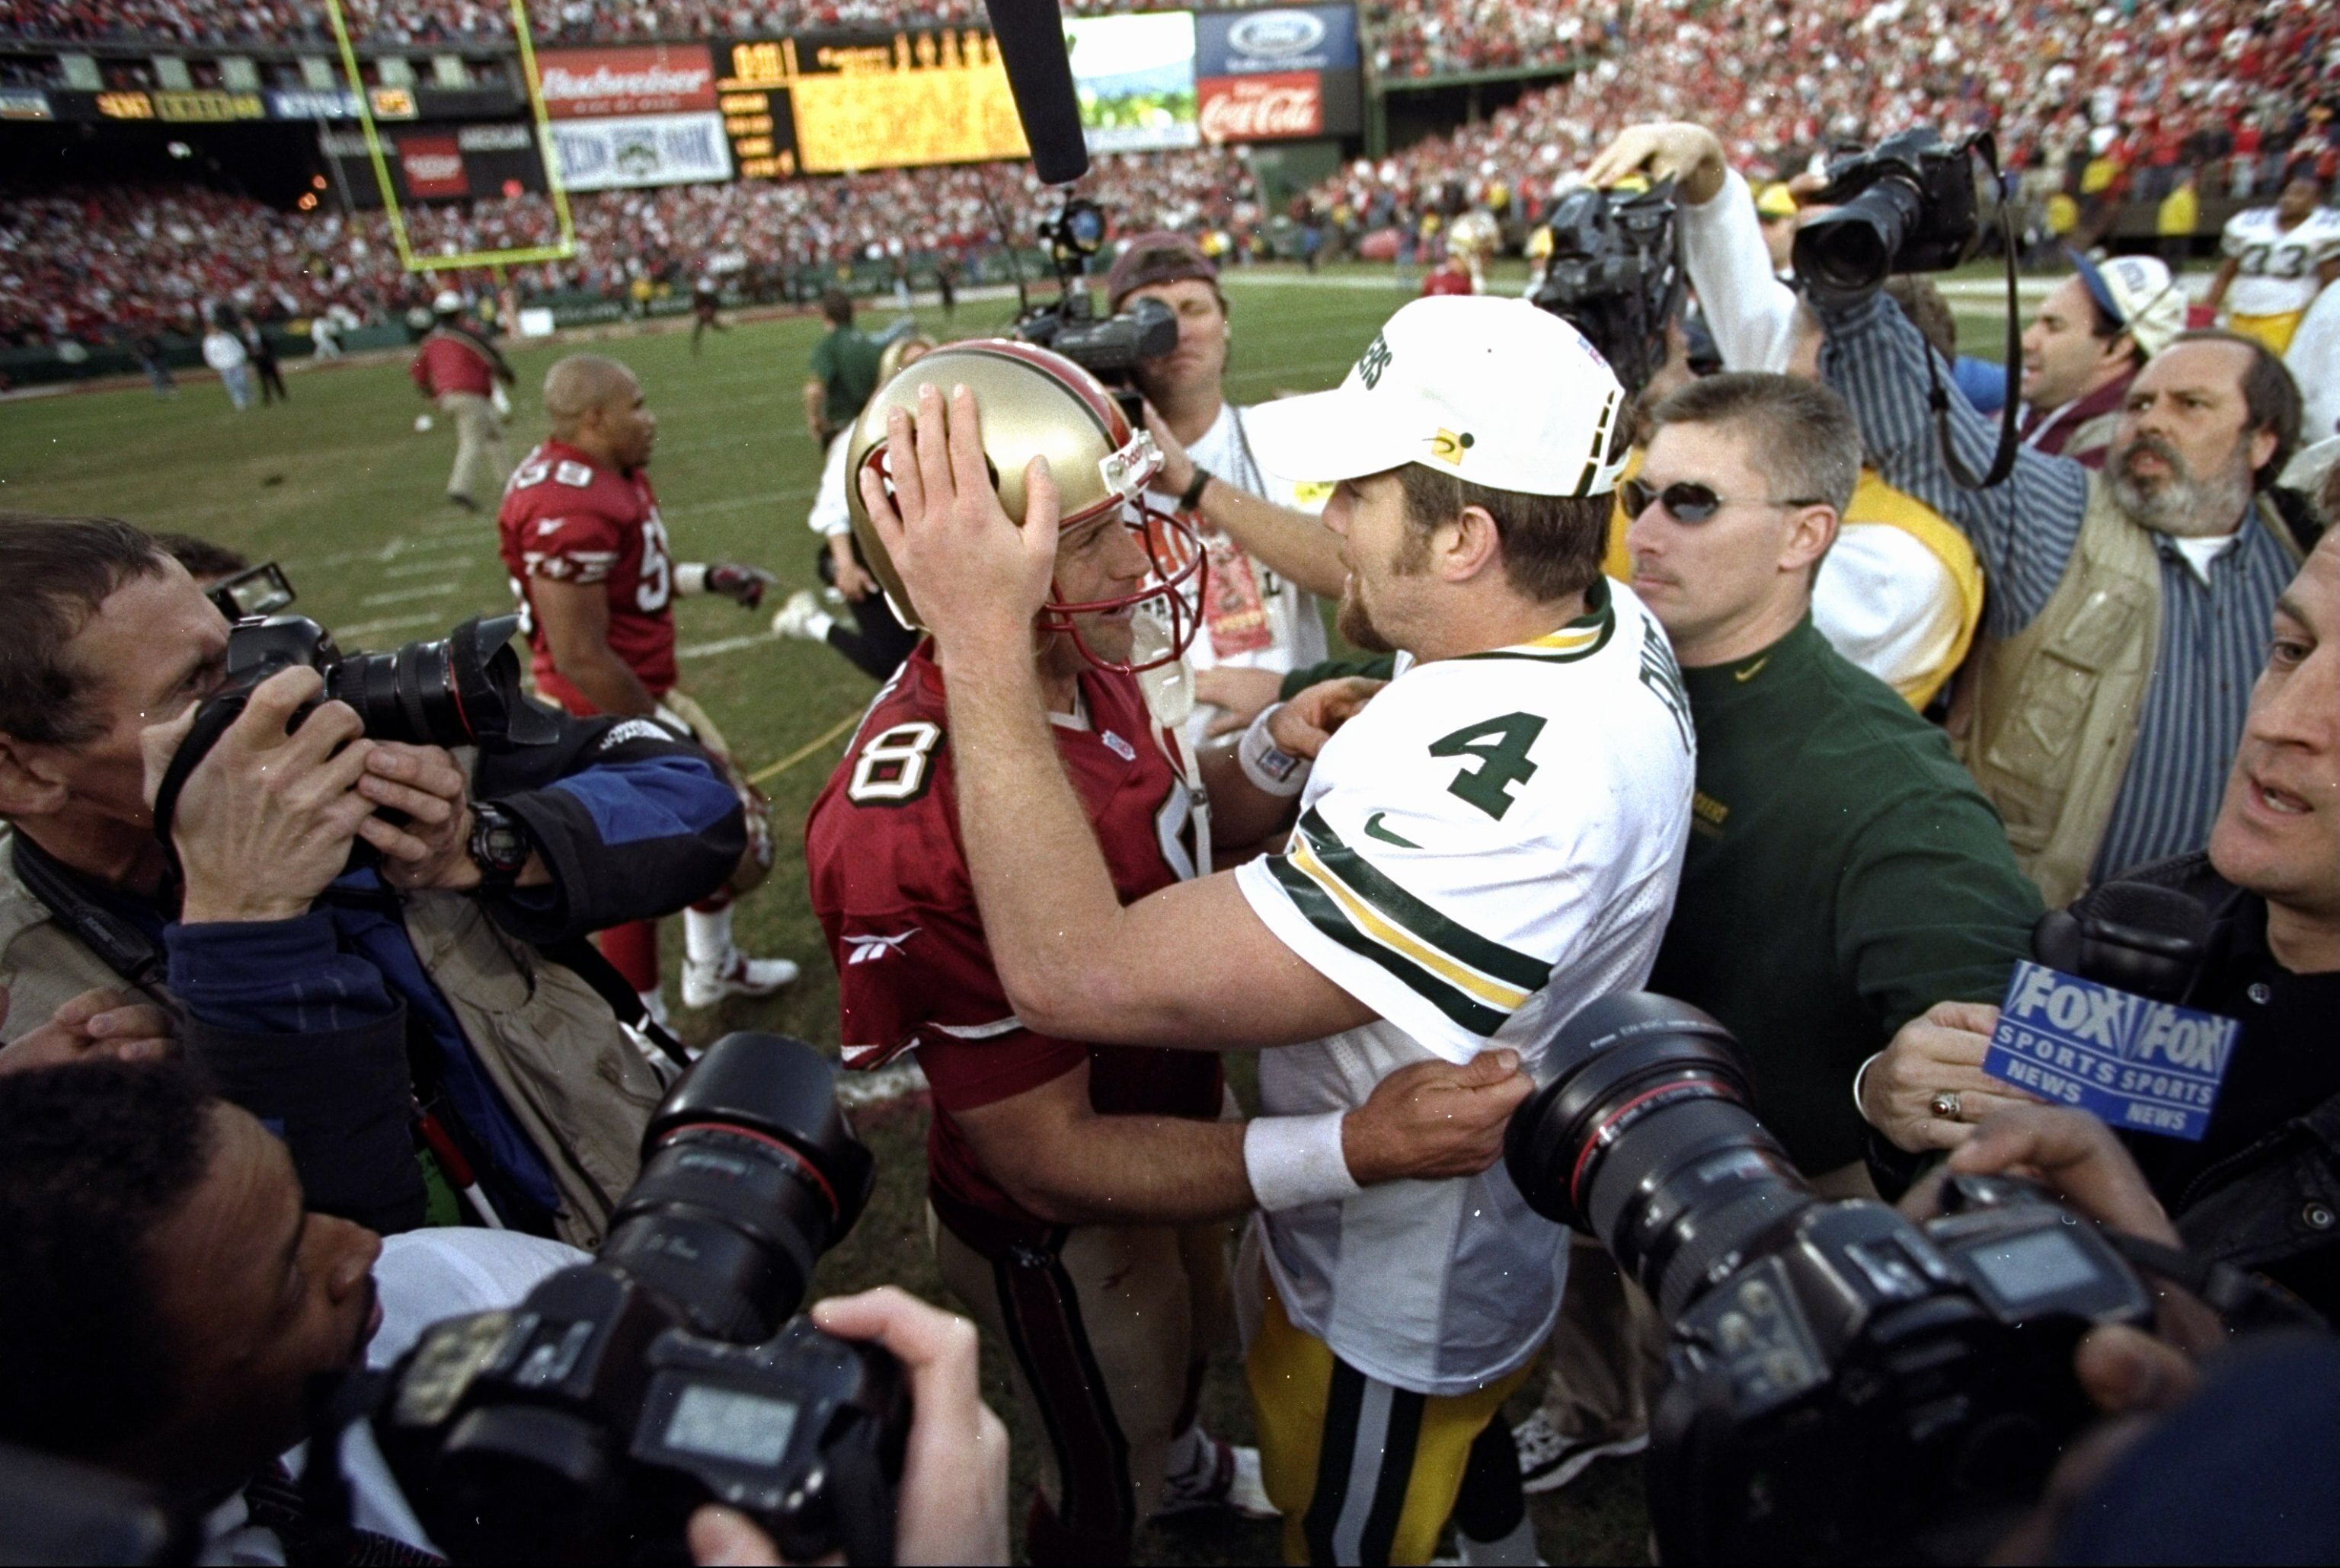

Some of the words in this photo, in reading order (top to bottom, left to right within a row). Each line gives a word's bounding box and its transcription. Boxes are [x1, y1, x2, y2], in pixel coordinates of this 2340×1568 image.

[848, 721, 945, 806] 8
[1427, 711, 1549, 822] 4
[2016, 965, 2123, 1049] FOX
[2138, 1003, 2227, 1072] FOX
[1996, 1024, 2117, 1084] SPORTS
[2006, 1059, 2083, 1104] NEWS
[2121, 1069, 2213, 1105] SPORTS
[2124, 1101, 2188, 1132] NEWS
